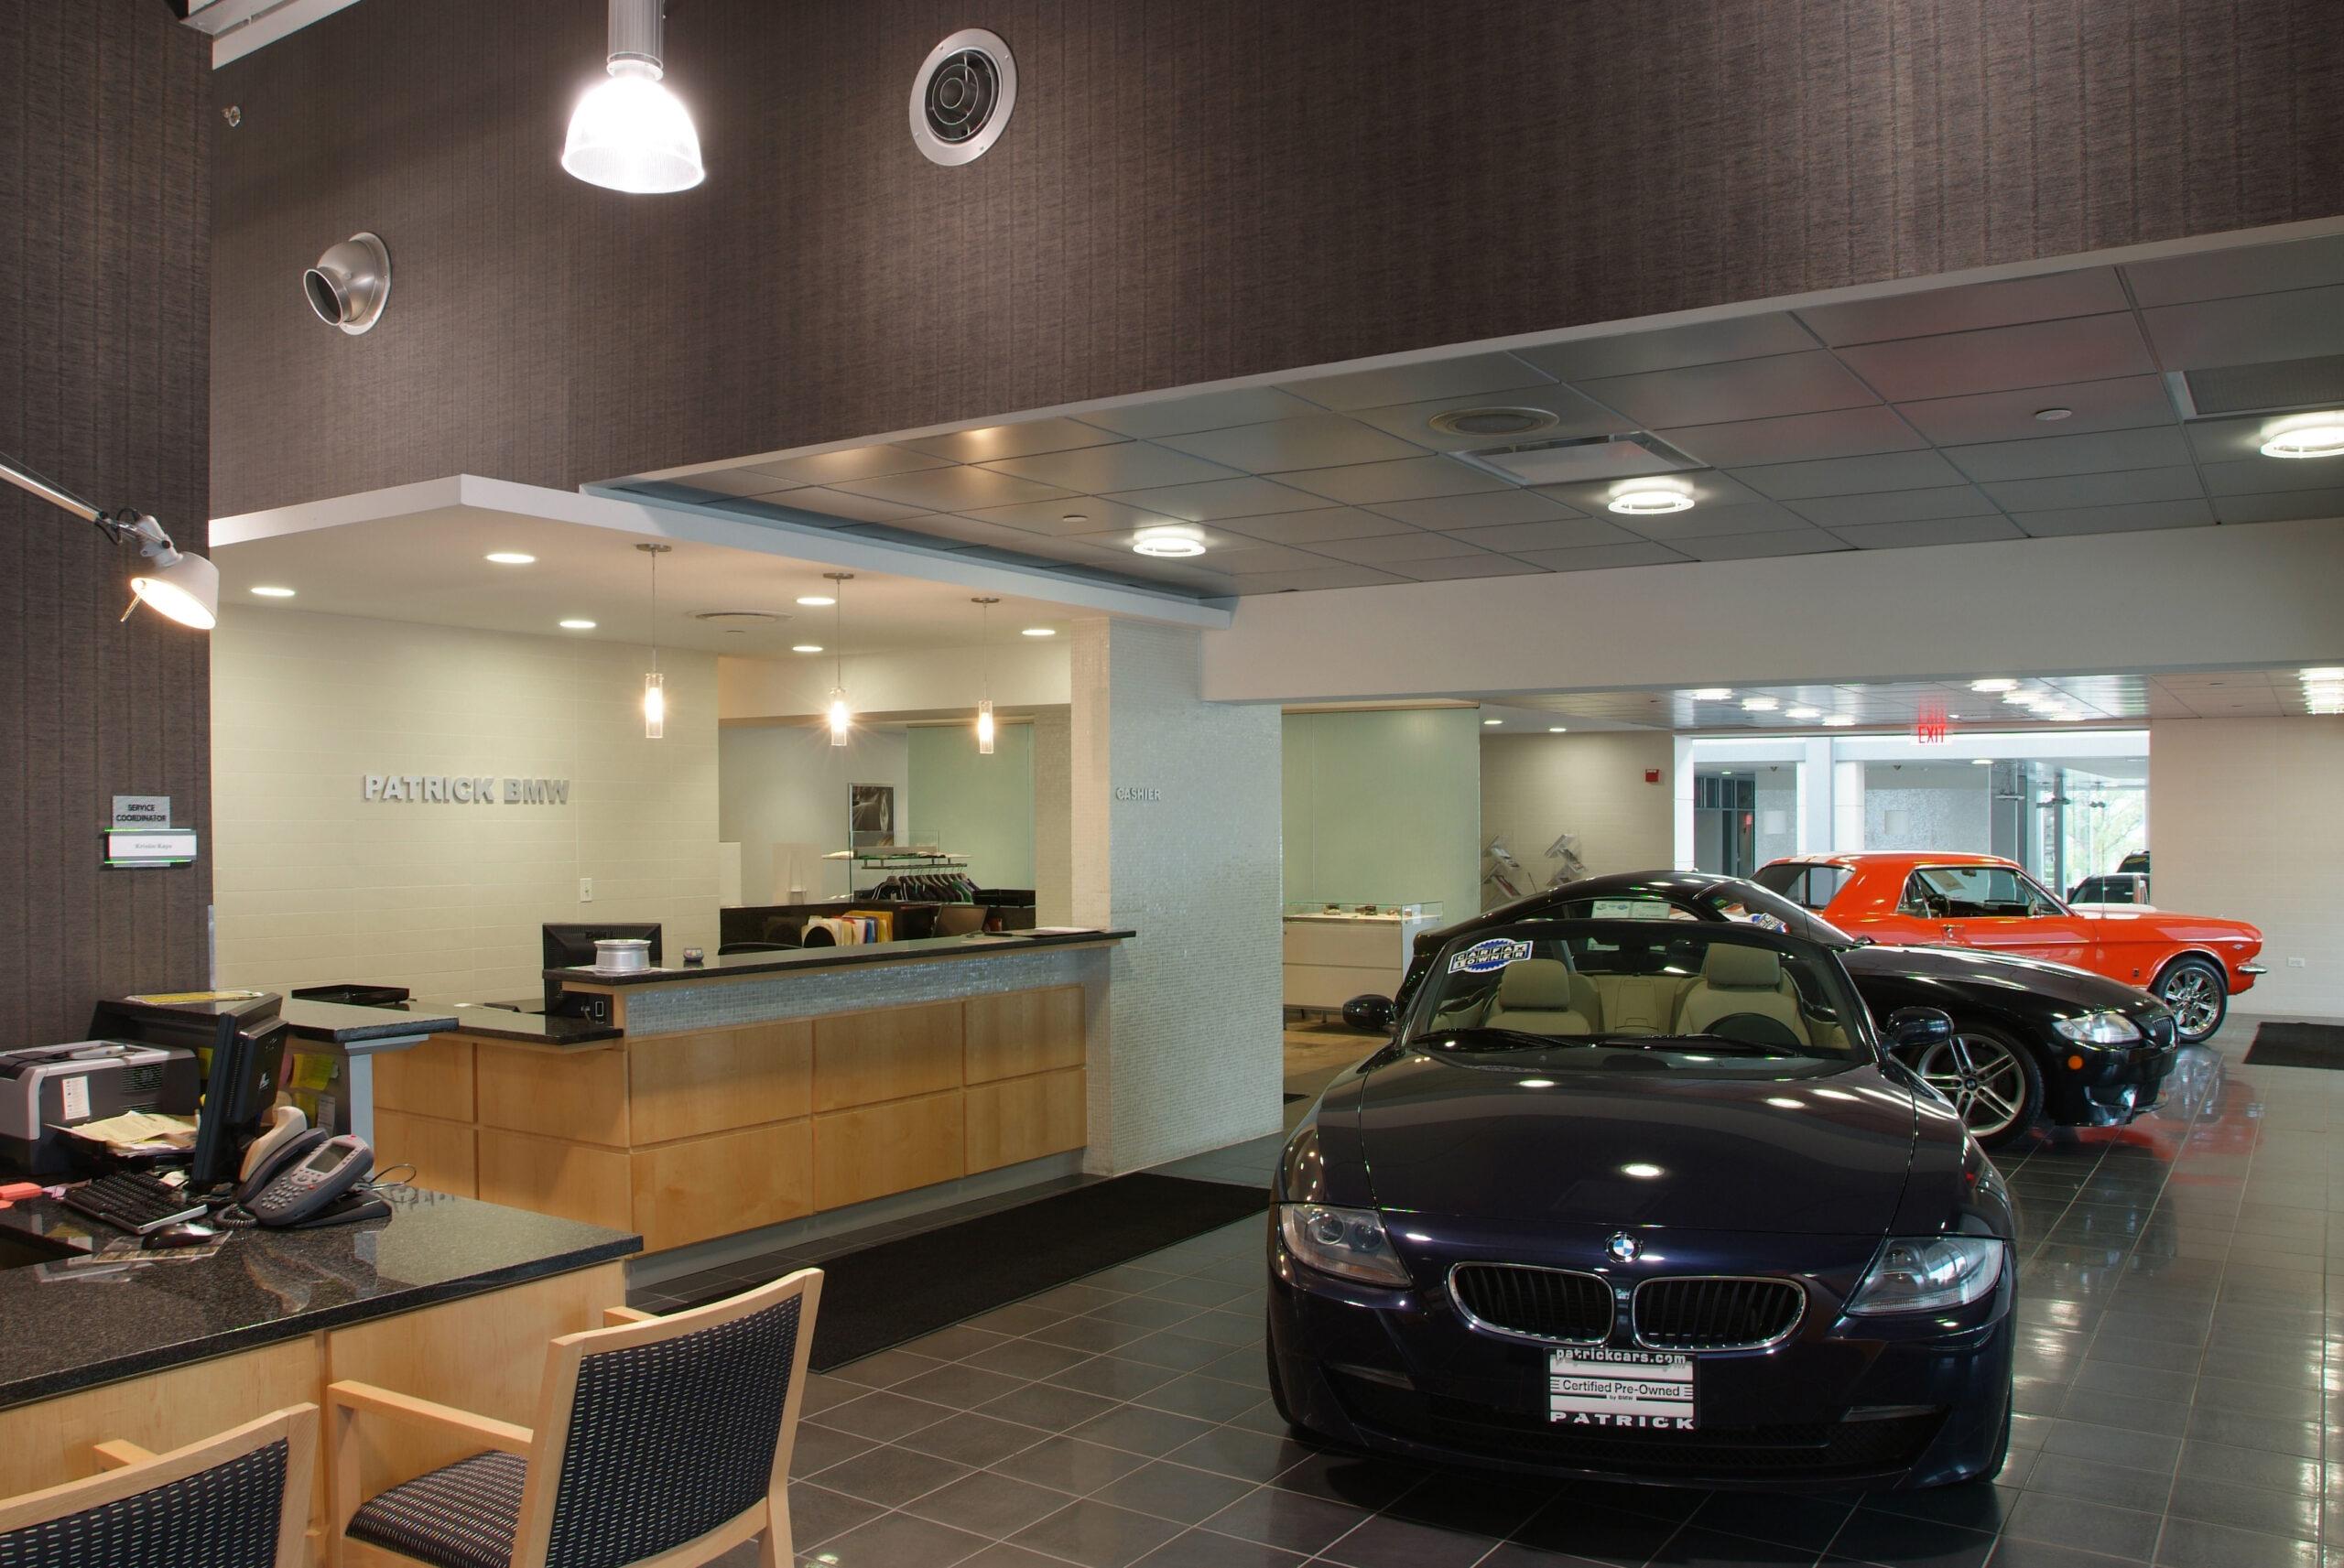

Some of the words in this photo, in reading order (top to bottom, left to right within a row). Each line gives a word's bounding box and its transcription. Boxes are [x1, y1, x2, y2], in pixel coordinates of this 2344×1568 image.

[1918, 725, 1947, 743] EXIT
[364, 775, 495, 804] PATRICK
[503, 778, 570, 805] BMW
[1116, 787, 1161, 801] CASHIER
[128, 804, 156, 812] SERVICE
[115, 814, 167, 822] COORDINATOR
[1456, 945, 1525, 961] CARFAX
[1556, 1347, 1687, 1365] patrickcars.com
[1562, 1379, 1612, 1392] Certified
[1614, 1382, 1680, 1397] Pre-Owned
[1550, 1411, 1695, 1430] PATRICK
